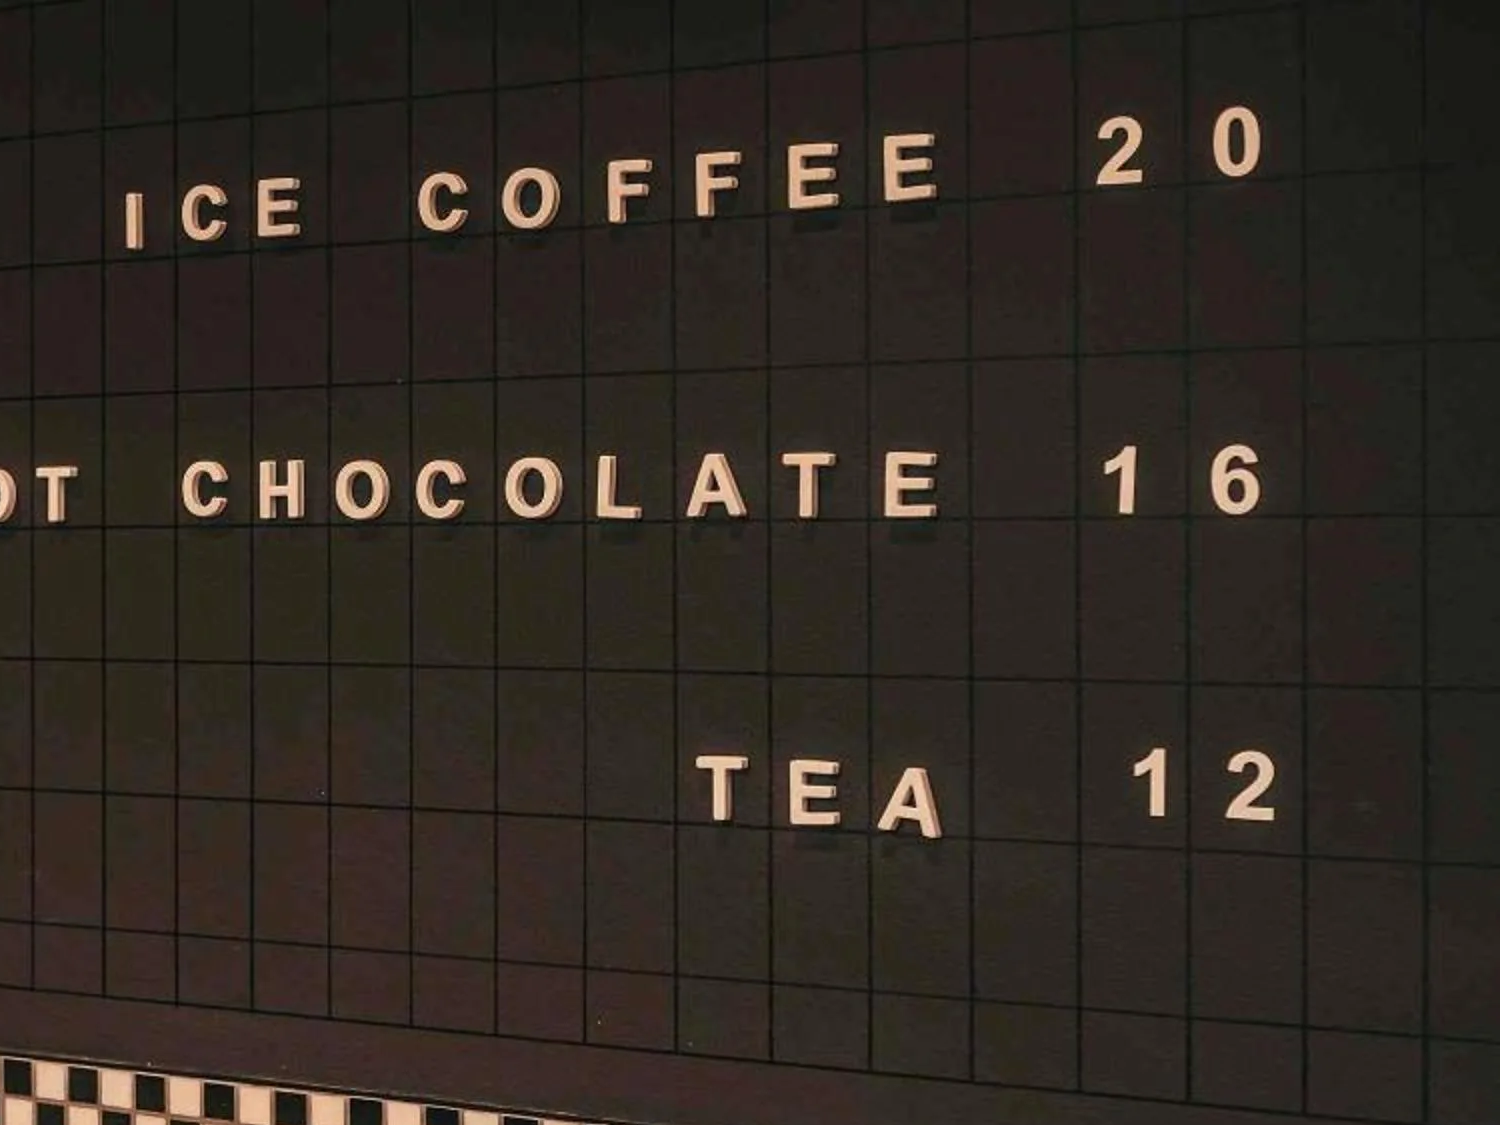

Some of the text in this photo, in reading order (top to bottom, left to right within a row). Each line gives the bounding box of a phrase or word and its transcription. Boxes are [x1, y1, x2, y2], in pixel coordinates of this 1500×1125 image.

[125, 106, 1261, 249] ICE COFFEE 20
[181, 451, 938, 520] CHOCOLATE
[1103, 443, 1260, 518] 16
[695, 747, 1275, 839] TEA 12
